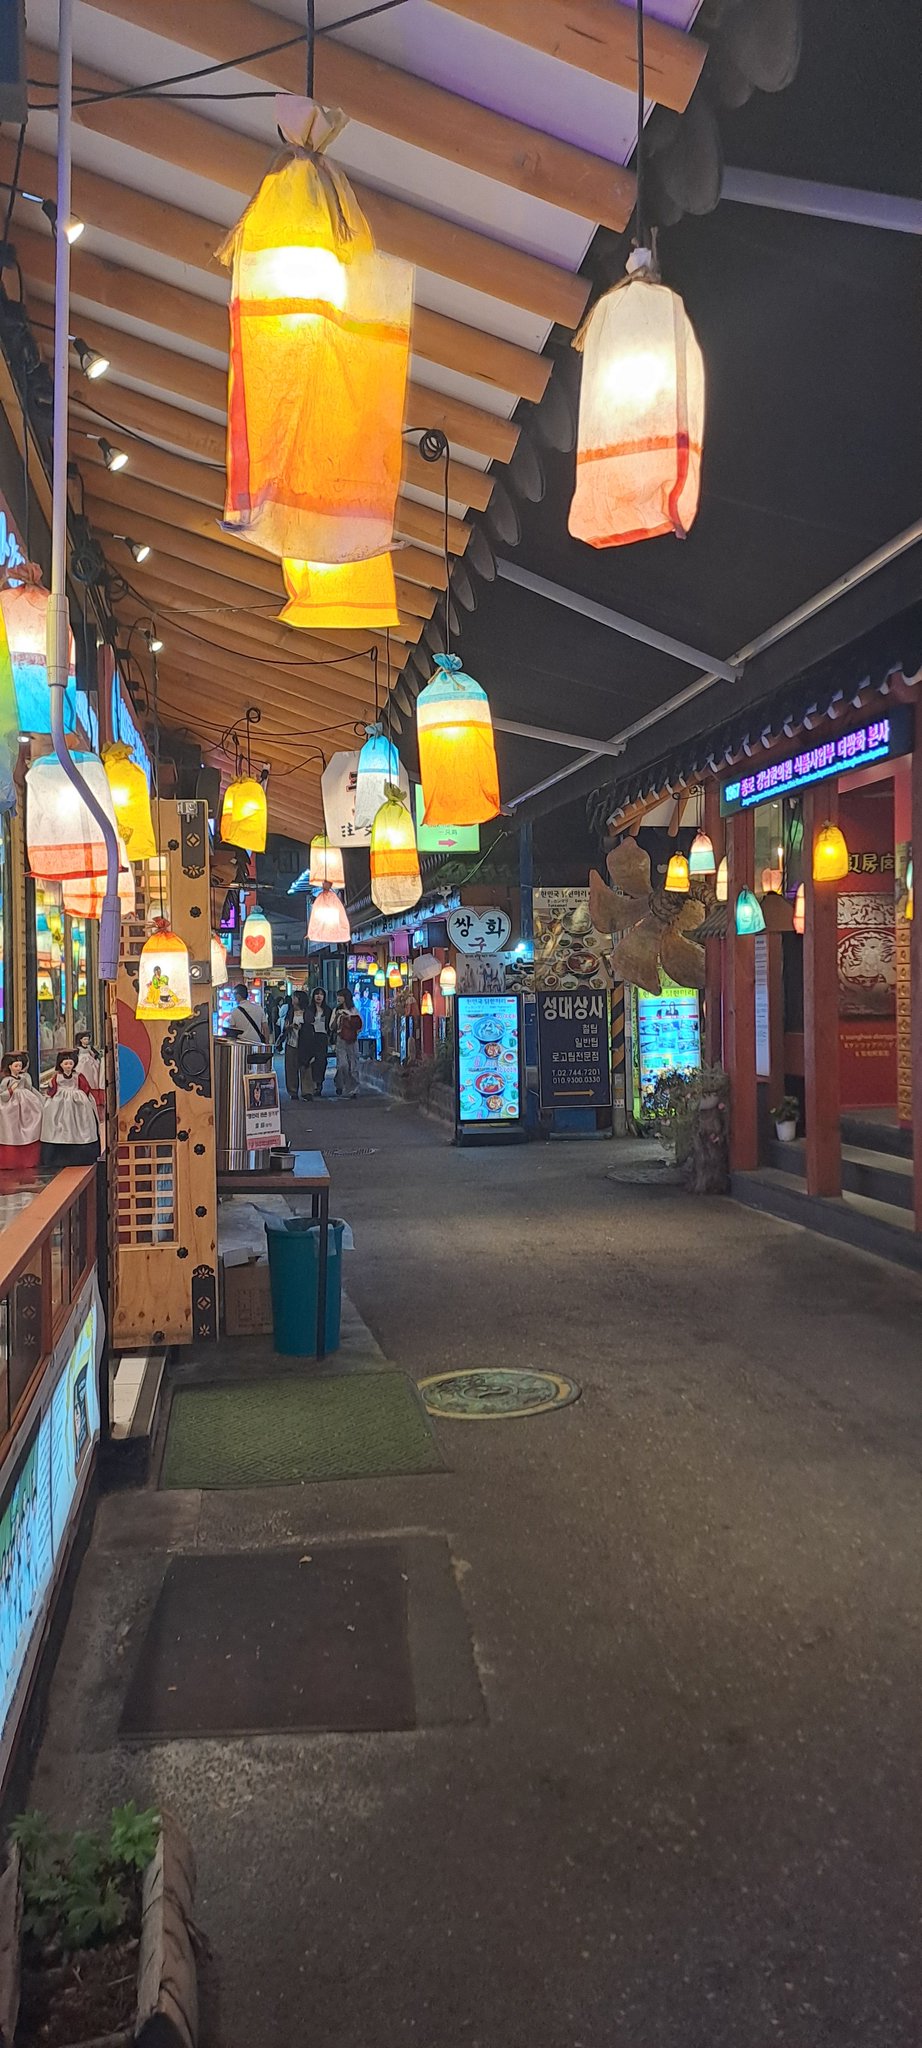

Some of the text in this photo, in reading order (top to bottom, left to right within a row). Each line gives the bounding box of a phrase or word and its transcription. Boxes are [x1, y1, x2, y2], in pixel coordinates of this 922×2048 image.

[741, 776, 755, 797] 종로
[756, 759, 793, 791] 강남한의원
[793, 742, 836, 775] 식품사업부
[837, 729, 867, 758] 더쌍화
[867, 719, 890, 748] 본사
[542, 996, 604, 1020] 성대상사
[552, 1051, 599, 1062] 로고팁전문점
